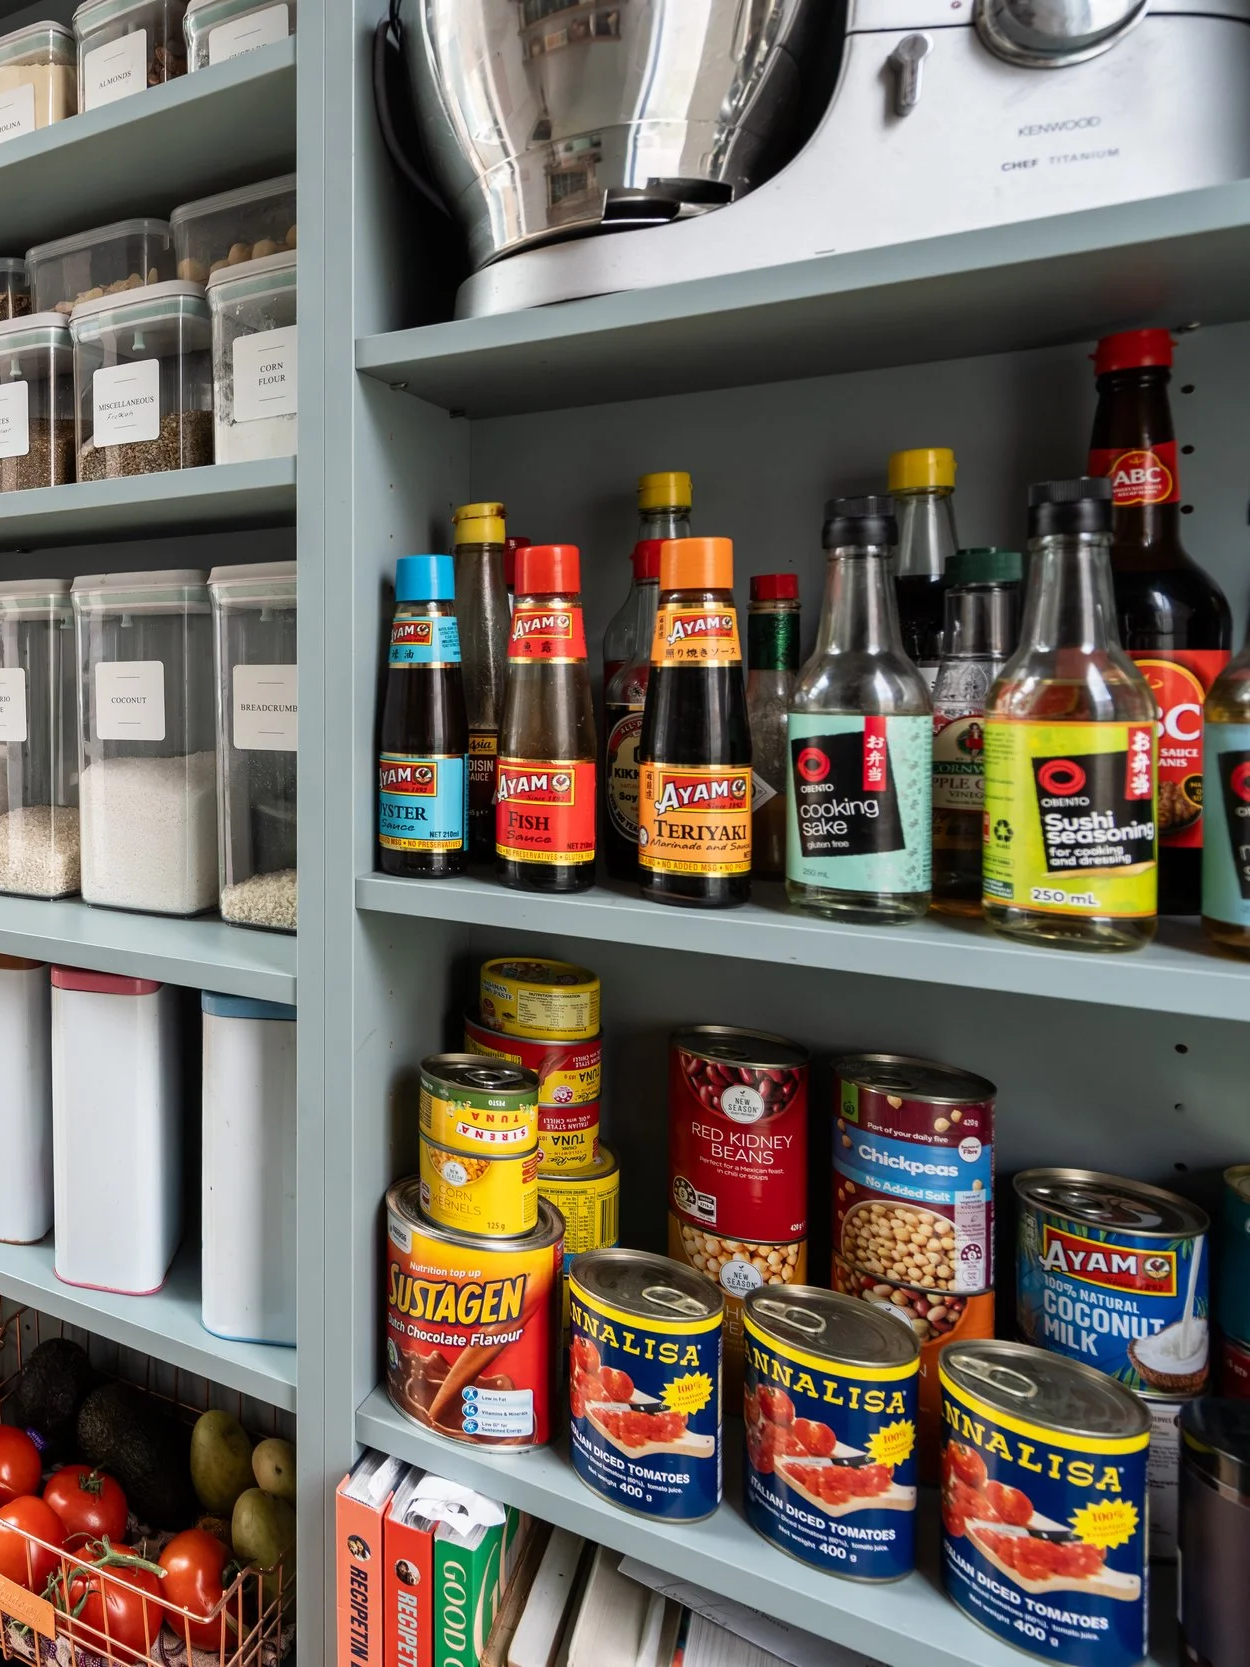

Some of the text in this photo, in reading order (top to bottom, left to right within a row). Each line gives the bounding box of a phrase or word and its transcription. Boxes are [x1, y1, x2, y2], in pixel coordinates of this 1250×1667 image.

[98, 70, 132, 89] ALMONDS
[1018, 116, 1102, 137] KENWOOD
[1001, 147, 1120, 172] CHEF TITANIUM
[260, 361, 284, 374] CORN
[258, 374, 287, 387] FLOUR
[98, 396, 155, 412] MISCELLANEOUS
[1113, 467, 1162, 487] ABC
[512, 616, 555, 641] AYAM
[667, 616, 720, 645] AYAM
[240, 703, 298, 713] BREADCRUMB
[866, 735, 885, 782] お弁当
[1161, 748, 1199, 757] SAUCE
[933, 763, 985, 775] CORNW
[1130, 731, 1150, 795] お弁当
[1158, 758, 1187, 767] ANIS
[497, 774, 548, 802] AYAM
[800, 783, 834, 794] OBENTO
[932, 776, 970, 790] PPLE
[618, 791, 638, 804] Soy
[654, 780, 729, 816] AYAM
[950, 790, 985, 800] VINEG
[1040, 797, 1091, 808] OBENTO
[800, 798, 880, 818] cooking
[381, 818, 416, 832] Sauce
[507, 810, 551, 831] FISH
[653, 819, 747, 841] TERIYAKI
[802, 818, 848, 836] sake
[1044, 810, 1115, 831] Sushi
[506, 830, 552, 843] Sauce
[1046, 821, 1155, 845] seasoning
[418, 839, 461, 849] PRESERVATIVES
[650, 838, 728, 851] Marinade and
[807, 840, 850, 850] gluten free
[1049, 845, 1124, 858] for cooking
[513, 849, 558, 861] PRESERVATIVES
[1049, 853, 1132, 866] and dressing
[662, 860, 671, 869] NO
[673, 861, 698, 871] ADDED
[1032, 888, 1098, 906] 250 mL
[488, 1099, 506, 1107] PESTO
[727, 1103, 758, 1114] SEASON
[734, 1097, 750, 1106] NEW
[471, 1112, 519, 1123] TUNA
[543, 1117, 565, 1125] CHILLI
[568, 1120, 589, 1130] ITALIAN
[461, 1124, 526, 1141] SIRENA
[551, 1133, 586, 1146] TUNA
[691, 1121, 793, 1149] RED KIDNEY
[867, 1121, 949, 1143] Part of your daily five
[711, 1143, 774, 1165] BEANS
[858, 1144, 959, 1177] Chickpeas
[699, 1155, 723, 1167] Perfect
[723, 1161, 734, 1170] for
[740, 1165, 768, 1174] Mexican
[438, 1185, 473, 1202] CORN
[865, 1175, 951, 1202] No Added Salt
[432, 1194, 482, 1216] KERNELS
[486, 1222, 499, 1230] 125
[1039, 1239, 1138, 1275] AYAM
[409, 1261, 482, 1279] Nutrition top up
[733, 1271, 749, 1281] NEW
[726, 1276, 756, 1289] SEASON
[388, 1263, 525, 1325] SUSTAGEN
[1044, 1274, 1140, 1314] 100% NATURAL
[1043, 1289, 1165, 1340] COCONUT
[407, 1325, 467, 1346] Chocolate
[470, 1328, 524, 1347] Flavour
[570, 1301, 700, 1367] NNALISA
[1044, 1316, 1098, 1357] MILK
[677, 1379, 703, 1394] 100%
[465, 1406, 476, 1415] 14
[941, 1400, 1122, 1493] NNALISA
[593, 1445, 625, 1470] DICED
[627, 1463, 690, 1484] TOMATOES
[588, 1465, 653, 1502] Net weight 400 g
[647, 1483, 668, 1492] tomato
[785, 1503, 826, 1530] DICED
[828, 1521, 896, 1541] TOMATOES
[778, 1524, 858, 1563] Net weight 400 g
[797, 1524, 874, 1551] tomatoes tomato
[443, 1560, 467, 1652] GOOD
[976, 1573, 1110, 1630] DICED TOMATOES
[350, 1564, 369, 1662] RECIPETIN
[969, 1593, 1059, 1648] Net weight 400 g
[397, 1589, 418, 1667] RECIPET
